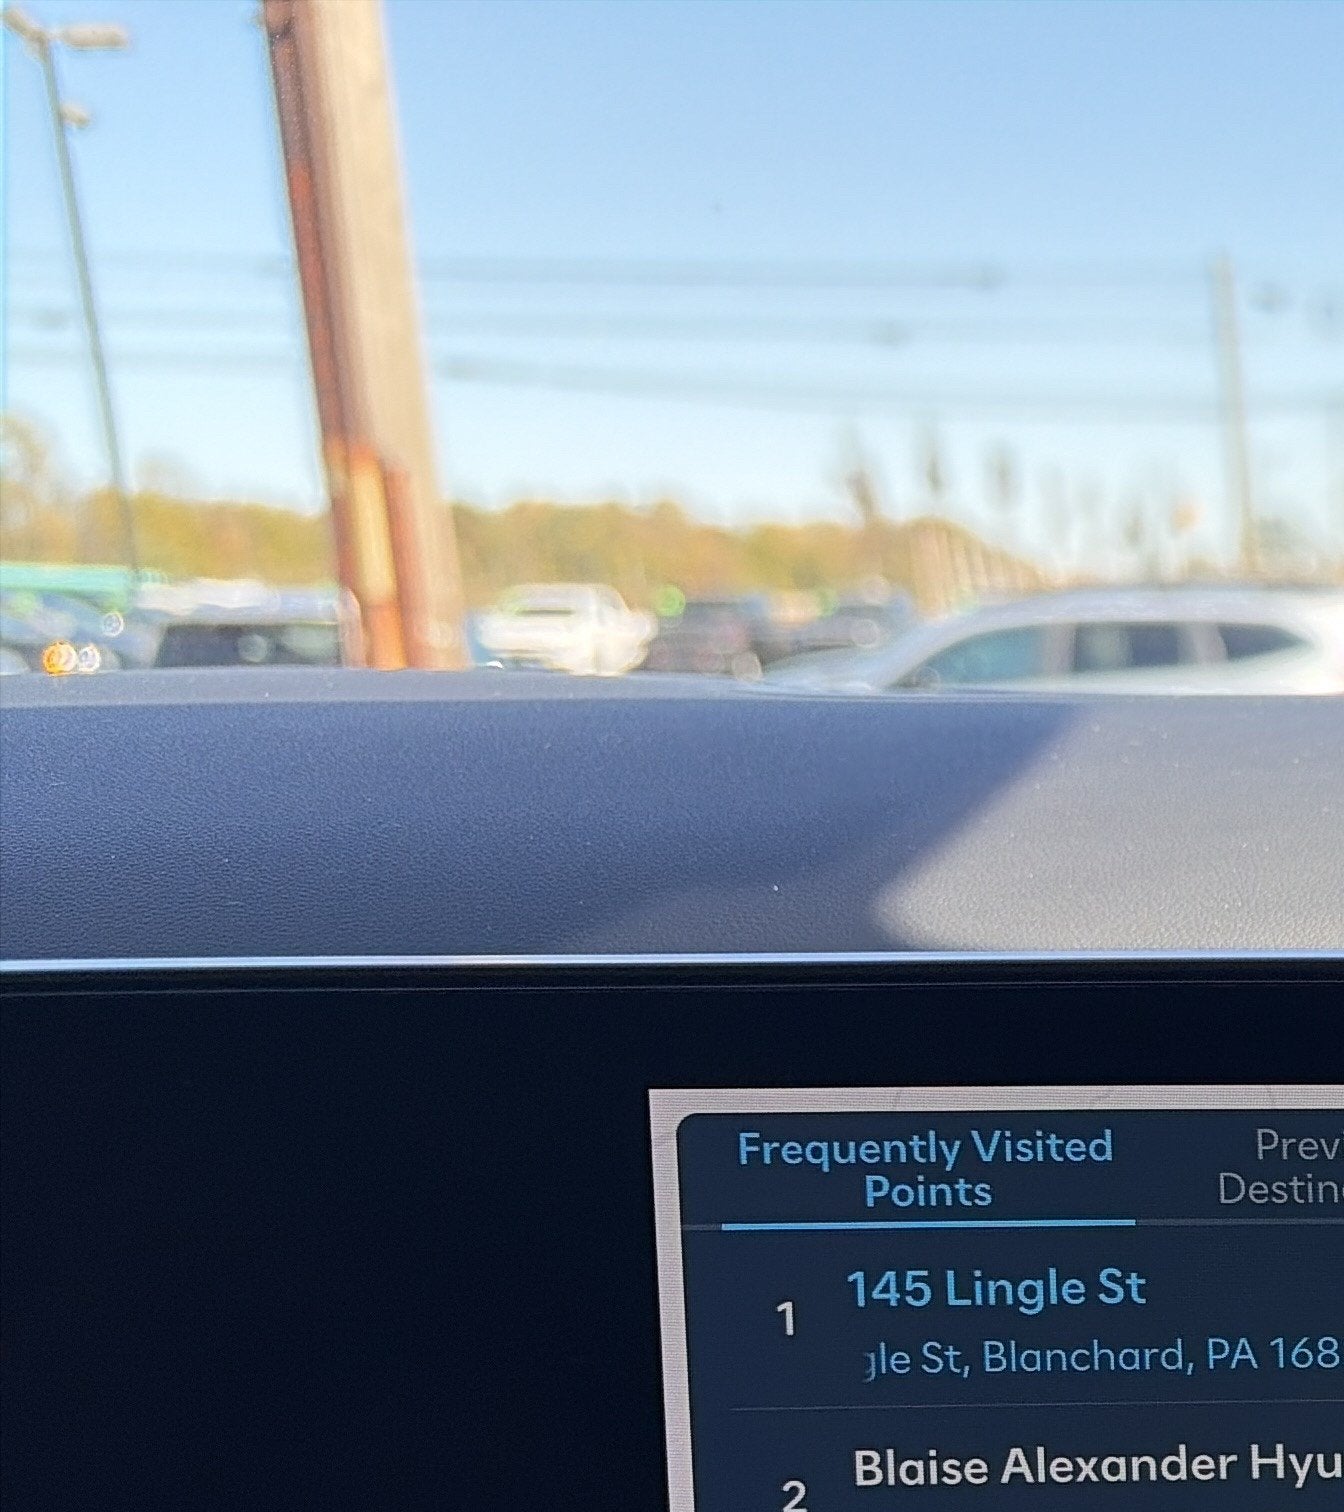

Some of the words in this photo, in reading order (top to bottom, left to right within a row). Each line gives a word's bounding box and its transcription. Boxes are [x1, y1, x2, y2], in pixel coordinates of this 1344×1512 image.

[738, 1132, 962, 1172] Frequently
[971, 1129, 1113, 1164] Visited
[865, 1175, 992, 1208] Points
[848, 1270, 931, 1308] 145
[945, 1268, 1085, 1314] Lingle
[1098, 1268, 1147, 1304] St
[777, 1302, 795, 1335] 1
[920, 1340, 971, 1379] St,
[984, 1339, 1195, 1377] Blanchard,
[1207, 1338, 1258, 1370] PA
[854, 1449, 989, 1487] Blaise
[1001, 1447, 1238, 1484] Alexander
